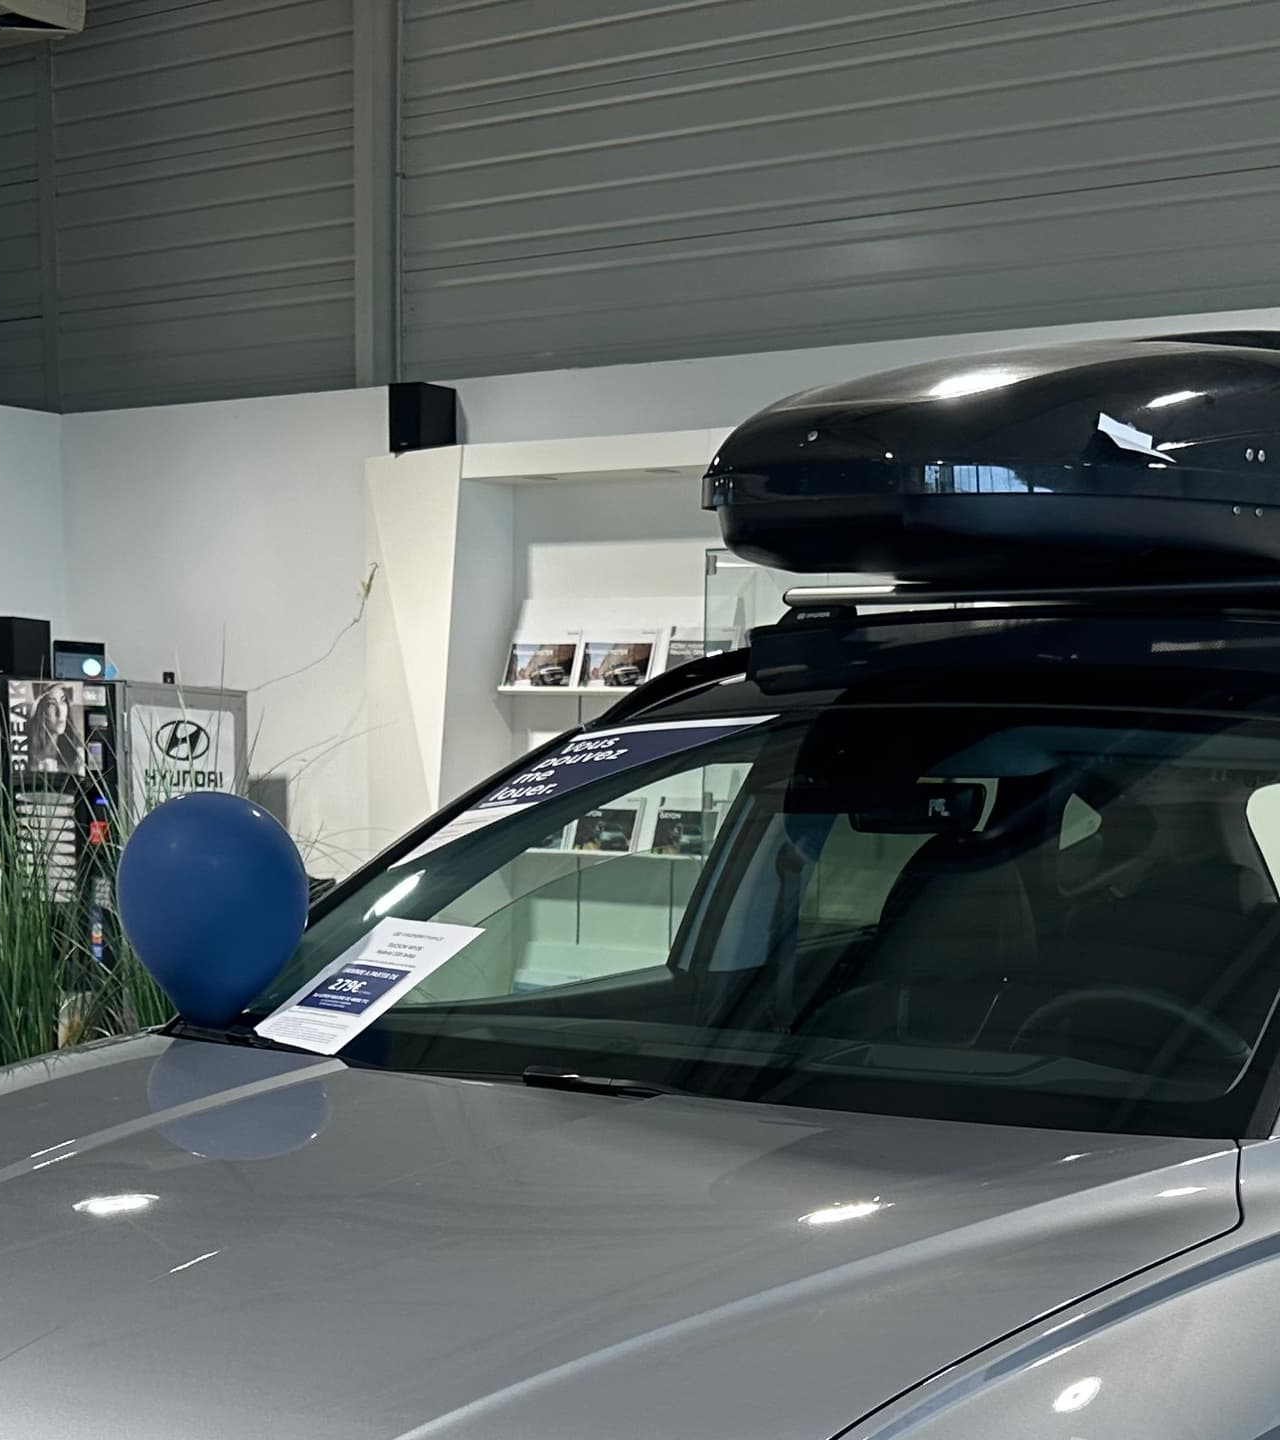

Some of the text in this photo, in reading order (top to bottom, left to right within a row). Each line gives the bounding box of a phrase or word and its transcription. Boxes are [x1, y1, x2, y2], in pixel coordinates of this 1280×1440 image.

[531, 748, 628, 772] pouvez
[512, 769, 555, 785] me
[488, 783, 558, 801] louer.
[328, 978, 367, 993] 279€
